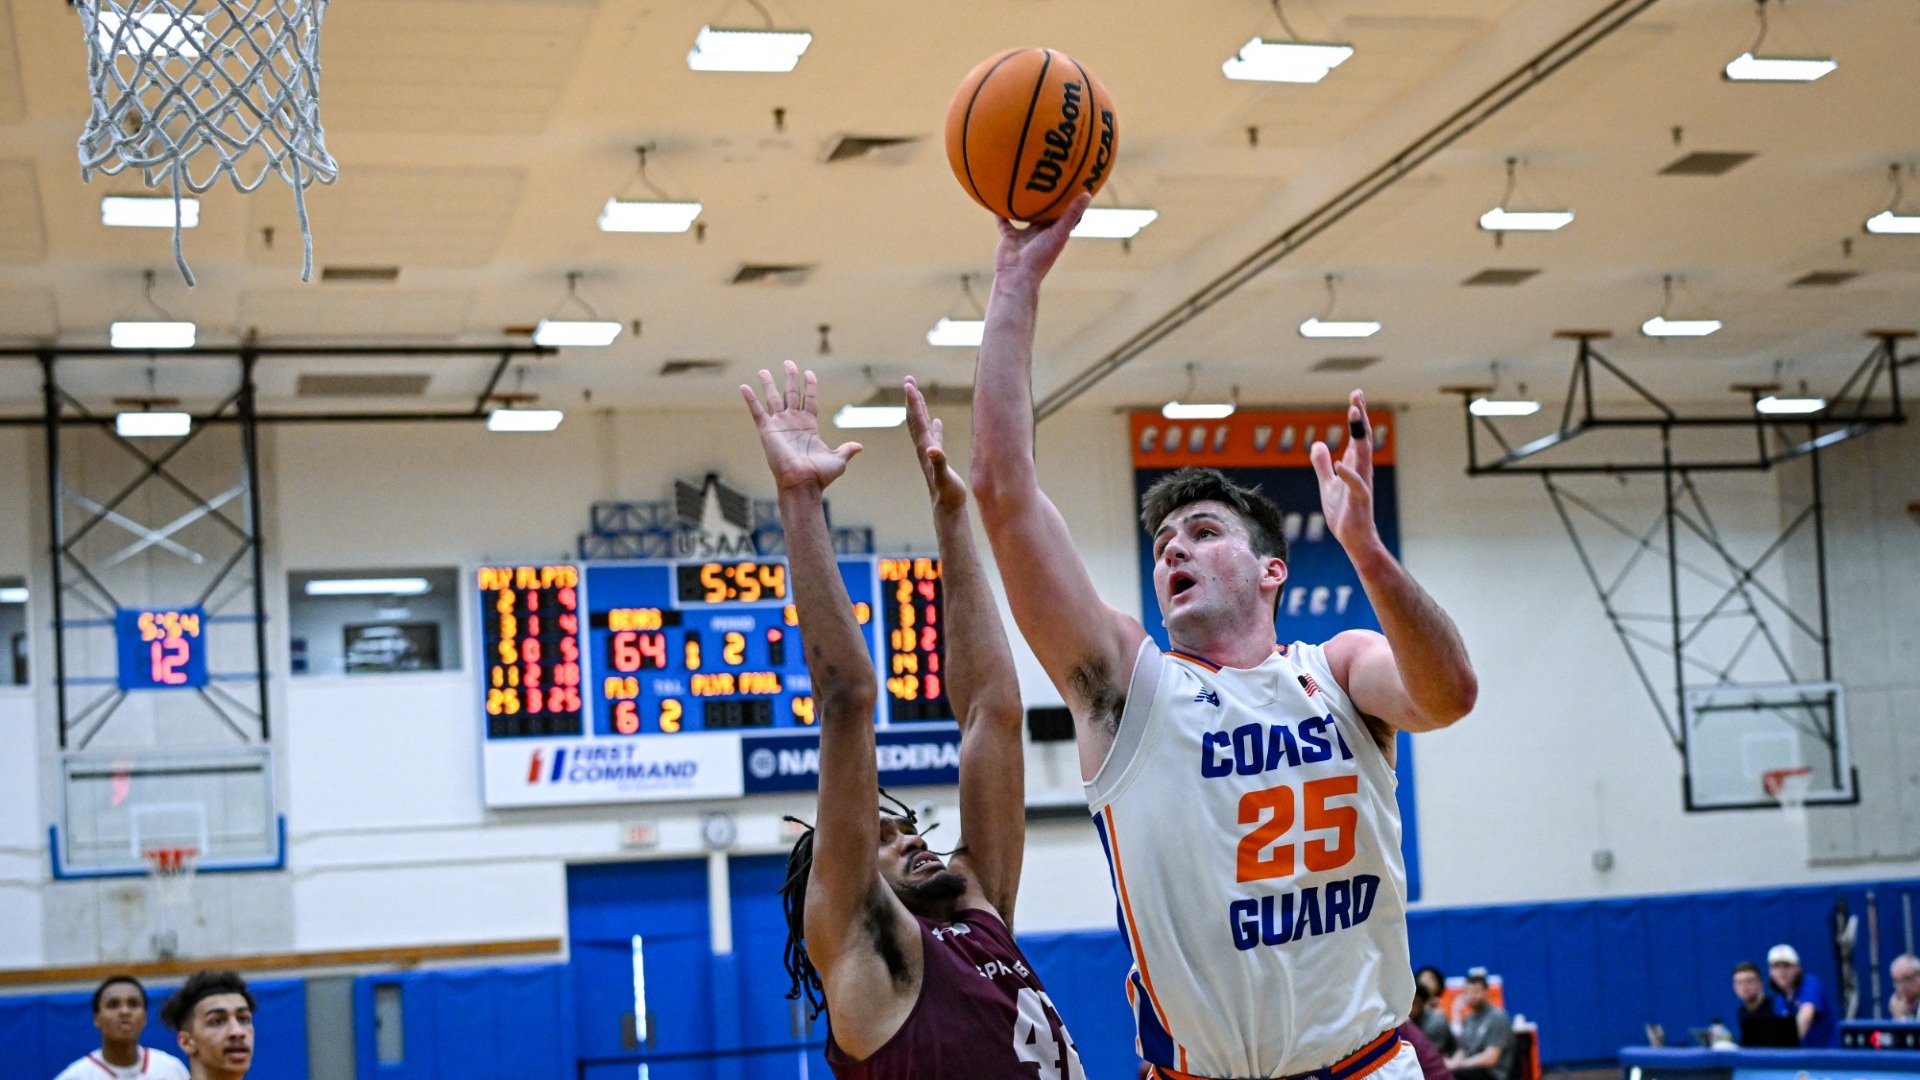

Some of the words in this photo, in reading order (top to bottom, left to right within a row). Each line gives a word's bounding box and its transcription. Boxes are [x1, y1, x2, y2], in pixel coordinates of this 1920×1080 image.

[1025, 81, 1082, 193] Wilson
[1082, 109, 1114, 193] NCAA
[1254, 424, 1389, 453] VALUS
[677, 533, 757, 557] USAA
[700, 562, 786, 603] 5:54
[137, 611, 200, 641] 5:54
[150, 637, 190, 685] 12
[614, 631, 666, 672] 64
[723, 631, 746, 665] 2
[615, 699, 640, 735] 6
[660, 698, 683, 733] 2
[791, 696, 815, 725] 4
[574, 743, 638, 761] FIRST
[1201, 713, 1355, 779] COAST
[569, 759, 699, 783] COMMAND
[1236, 775, 1358, 884] 25
[1229, 873, 1381, 951] GUARD
